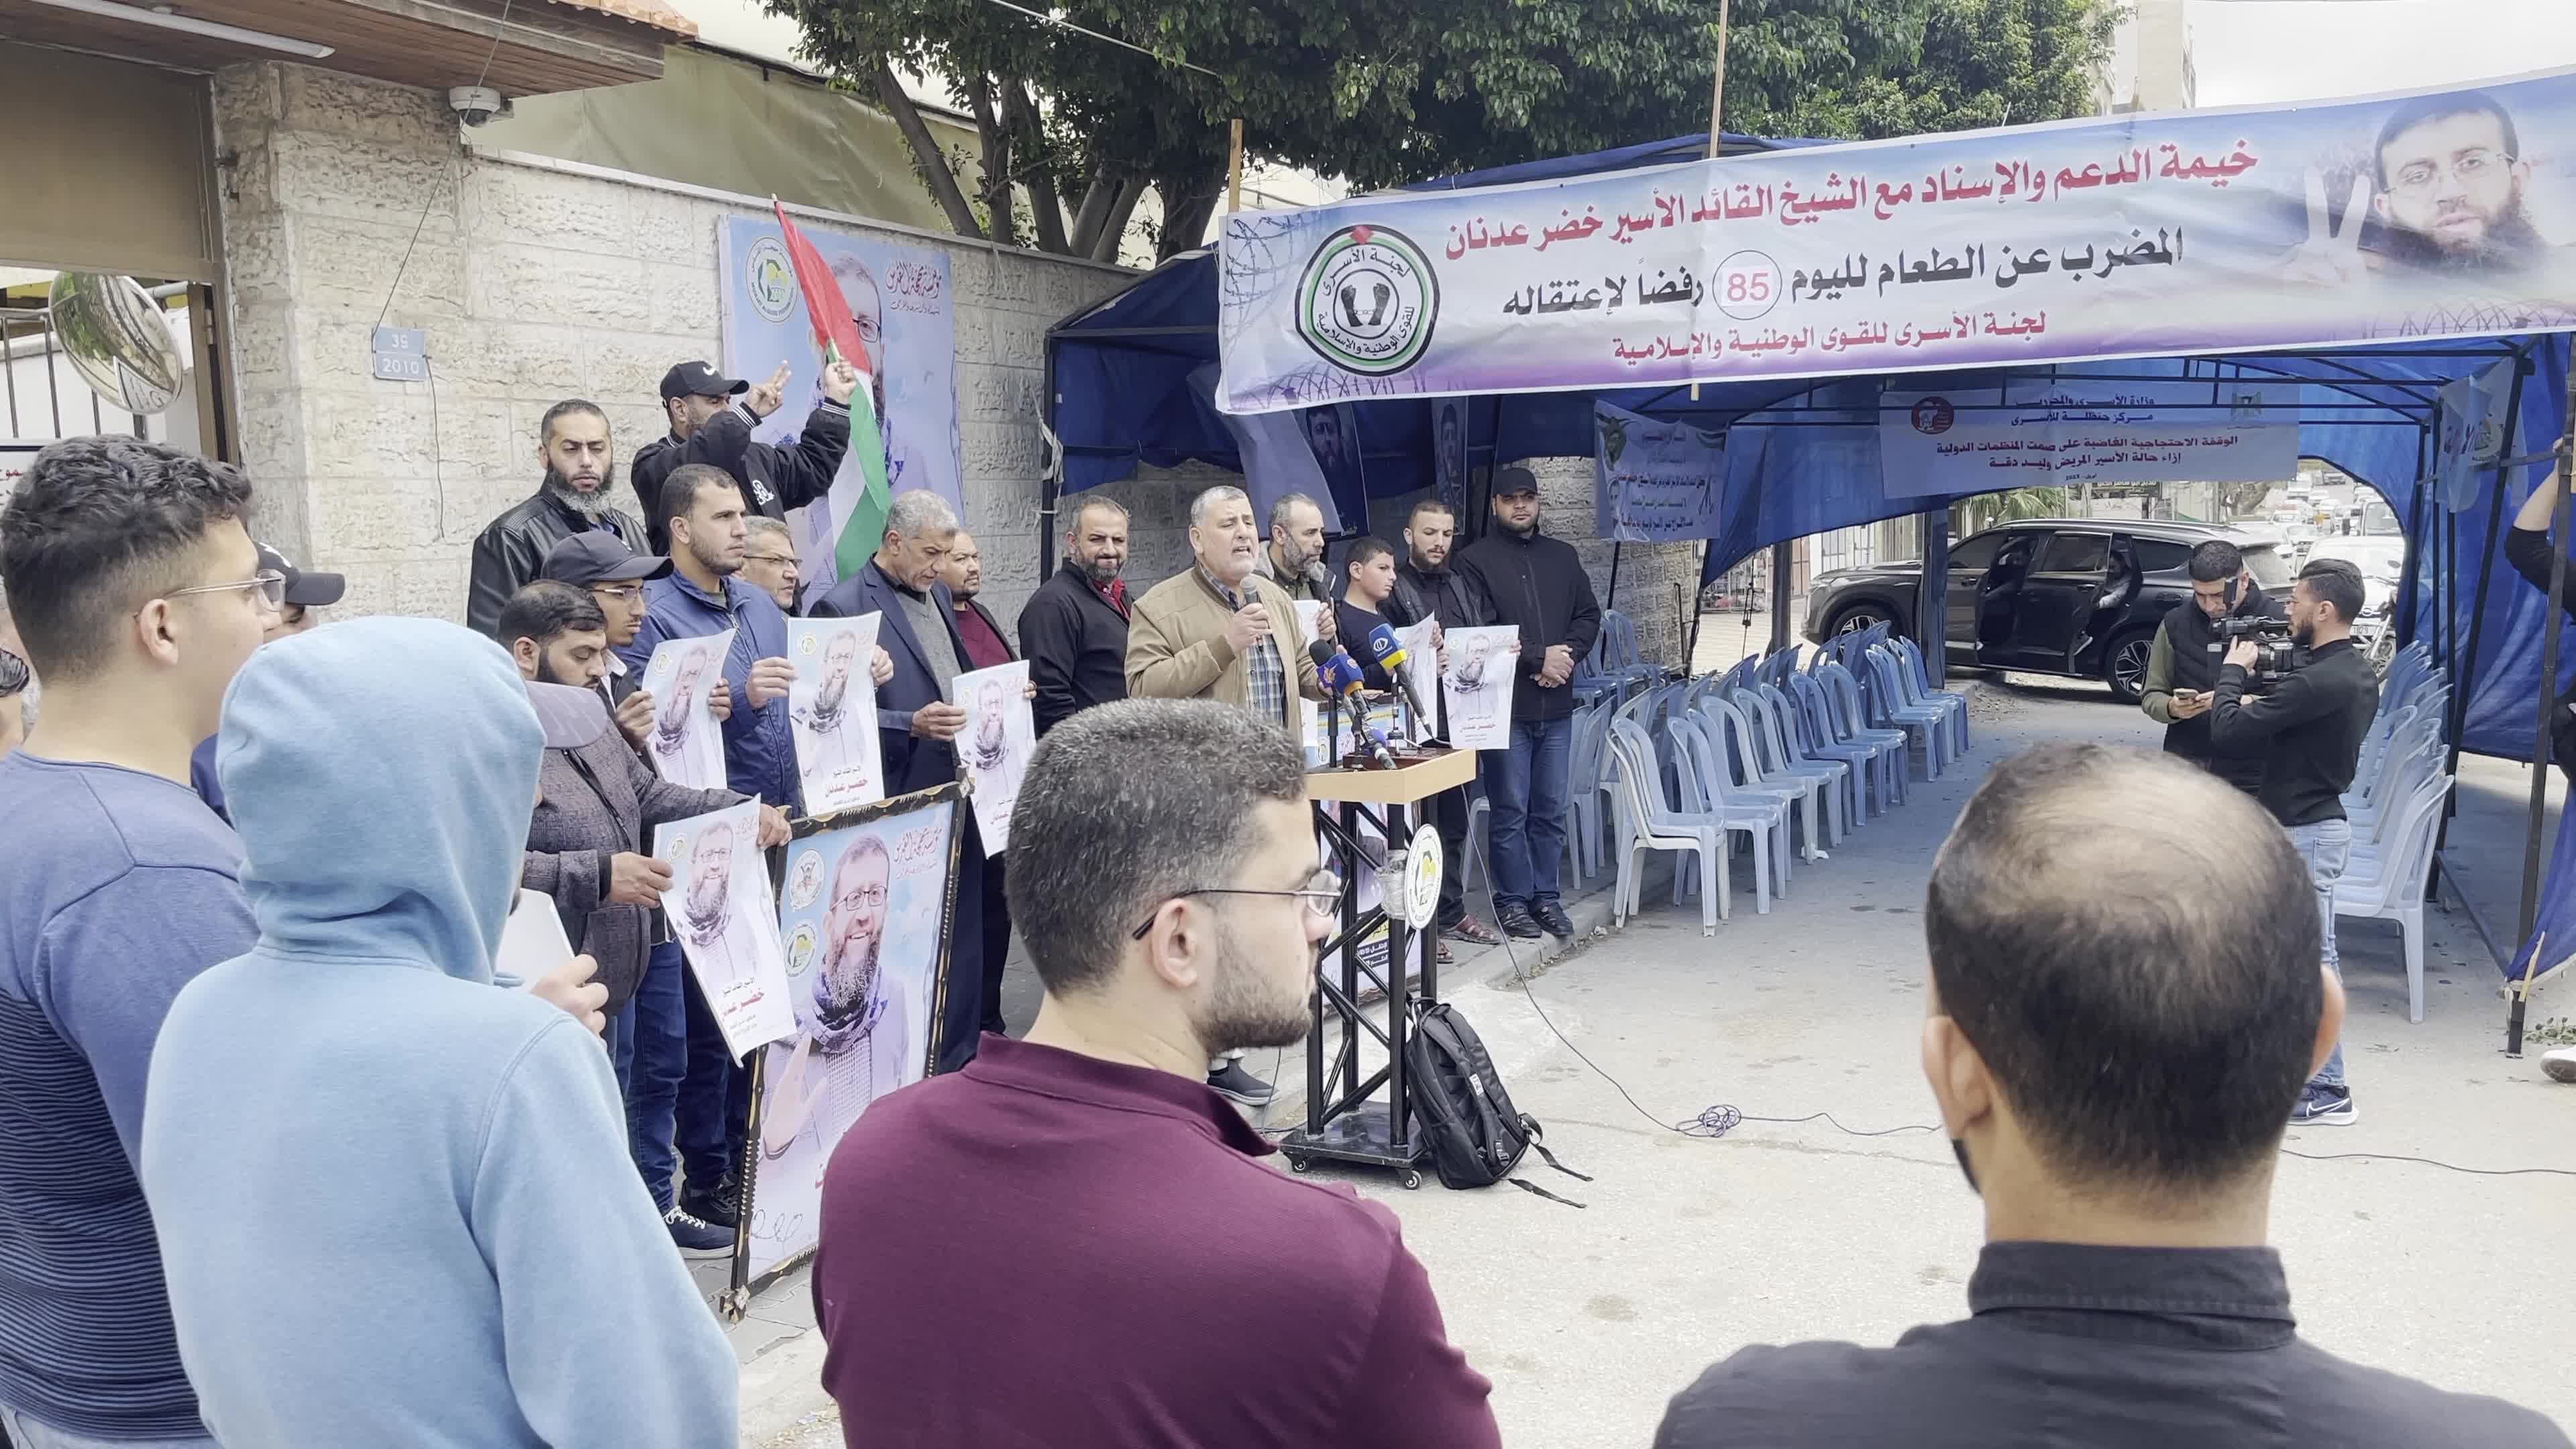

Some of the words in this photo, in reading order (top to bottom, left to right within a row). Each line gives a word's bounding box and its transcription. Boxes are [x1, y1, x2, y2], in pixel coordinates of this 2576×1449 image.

[1922, 160, 2046, 204] والإسناد
[2054, 149, 2151, 200] الدعم
[2159, 140, 2258, 188] خيمة
[1611, 188, 1686, 244] الأسير
[1692, 184, 1773, 223] القائد
[1780, 172, 1868, 226] الشيخ
[1874, 182, 1912, 220] مع
[1446, 216, 1529, 259] عدنان
[1535, 204, 1604, 252] خضر
[1370, 248, 1412, 278] لجنة
[1879, 242, 1984, 297] الطعام
[1995, 246, 2051, 288] عن
[2061, 225, 2183, 282] المضرب
[1322, 248, 1364, 296] الأسرى
[1727, 271, 1770, 302] 85
[1792, 251, 1868, 303] لليوم
[1399, 306, 1415, 339] للقوى
[1822, 321, 1888, 351] للقوى
[1894, 311, 1977, 347] الأسرى
[1984, 309, 2046, 340] لجنة
[1364, 334, 1400, 356] الوطنية
[1614, 331, 1723, 367] والإسلامية
[1729, 327, 1815, 358] الوطنية
[382, 358, 419, 375] 2010
[1937, 442, 1974, 457] الدولية
[2027, 441, 2056, 452] صمت
[2058, 438, 2081, 452] على
[2132, 452, 2158, 462] حالة
[2202, 435, 2238, 447] الوقفة
[2021, 457, 2051, 471] وليد
